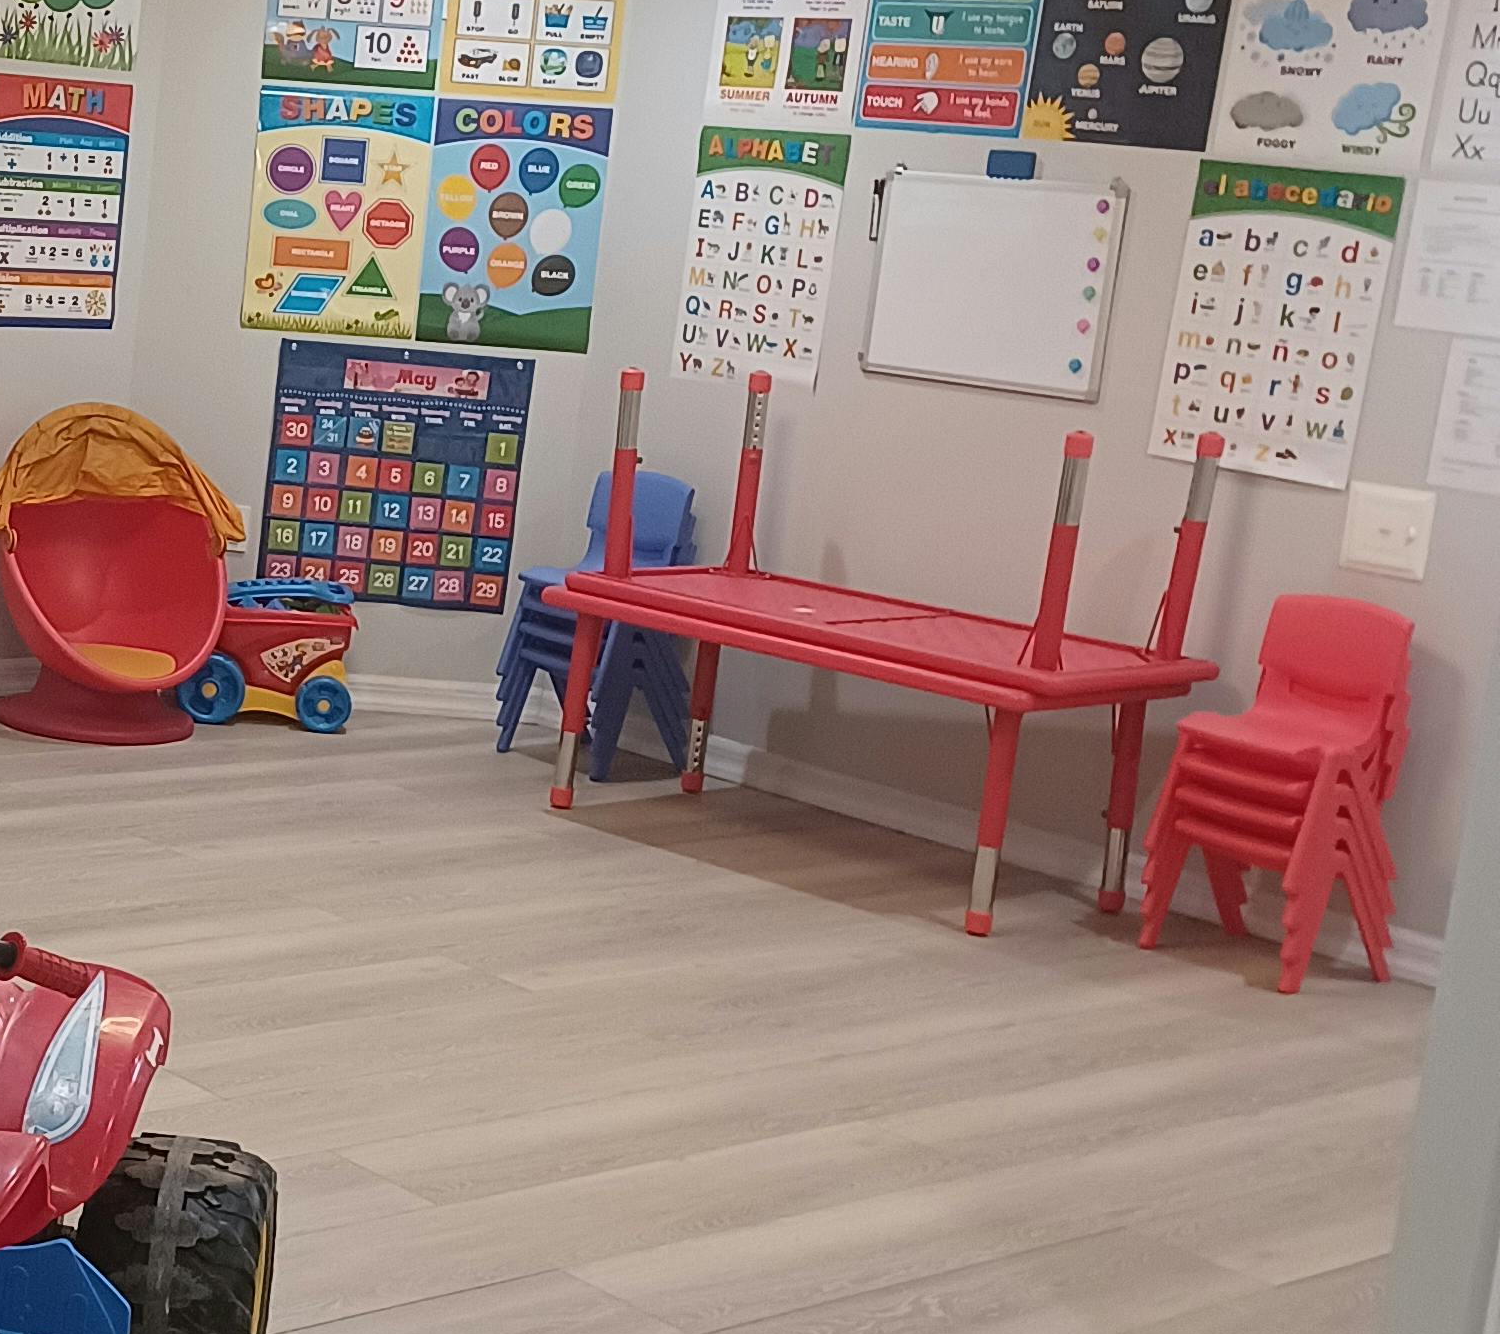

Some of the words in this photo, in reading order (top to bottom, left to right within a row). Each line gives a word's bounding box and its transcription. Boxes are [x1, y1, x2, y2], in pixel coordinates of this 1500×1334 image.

[879, 16, 911, 27] TASTE
[365, 32, 392, 54] 10
[872, 56, 918, 68] HEARING
[1367, 55, 1402, 65] RAINY
[22, 82, 105, 115] MATH
[720, 89, 770, 101] SUMMER
[786, 92, 838, 104] AUTUMN
[867, 95, 902, 108] TOUCH
[280, 95, 417, 127] SHAPES
[455, 108, 595, 140] COLORS
[709, 134, 835, 166] ALPHABET
[1257, 138, 1295, 148] FOGGY
[480, 161, 498, 170] RED
[527, 164, 550, 173] BLUE
[701, 180, 714, 199] A
[735, 183, 749, 202] B
[769, 186, 784, 205] C
[804, 189, 819, 208] D
[1199, 228, 1214, 247] a
[1244, 228, 1261, 251] b
[442, 246, 475, 255] PURPLE
[395, 370, 437, 390] May
[285, 422, 308, 437] 30
[287, 459, 297, 473] 2
[319, 461, 330, 476] 3
[356, 465, 367, 479] 4
[390, 468, 401, 482] 5
[424, 471, 435, 486] 6
[459, 474, 470, 488] 7
[496, 478, 507, 493] 8
[282, 493, 293, 508] 9
[314, 496, 332, 511] 10
[348, 500, 361, 513] 11
[383, 503, 400, 518] 12
[417, 505, 434, 520] 13
[450, 509, 467, 524] 14
[488, 513, 504, 529] 15
[276, 529, 292, 543] 16
[310, 531, 327, 546] 17
[345, 535, 362, 550] 18
[378, 538, 396, 553] 19
[412, 542, 434, 556] 20
[447, 544, 464, 559] 21
[482, 547, 502, 563] 22
